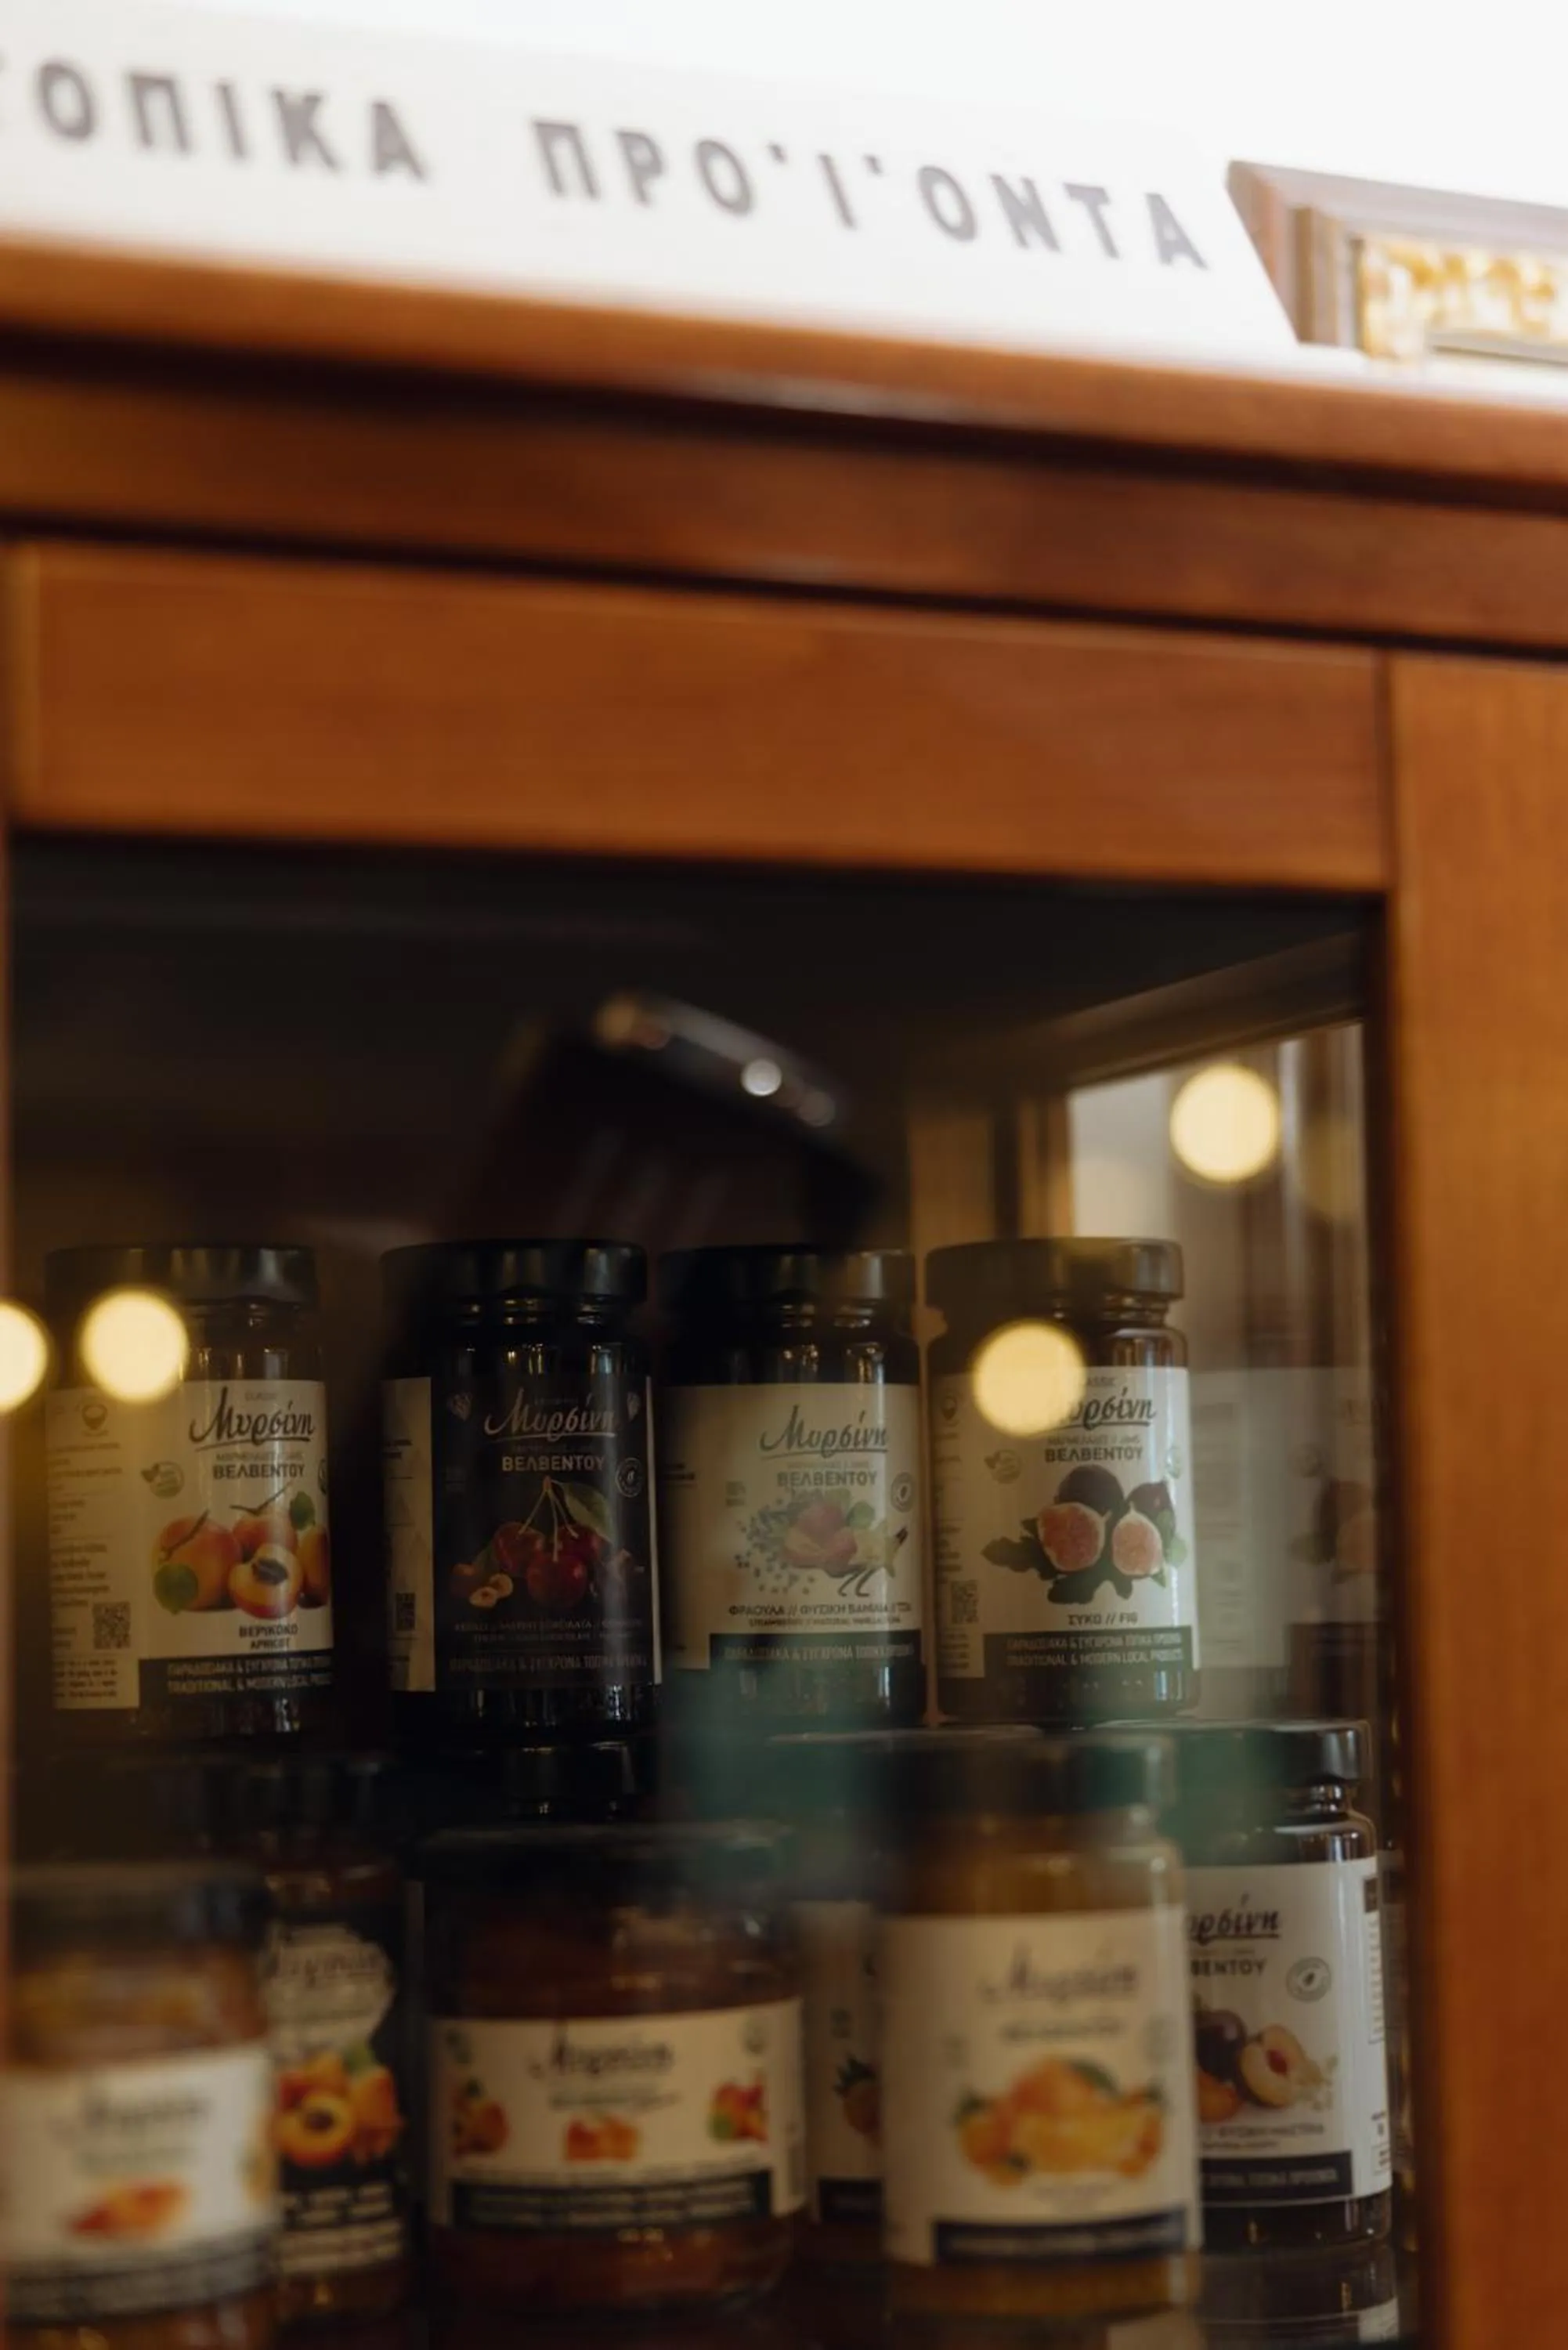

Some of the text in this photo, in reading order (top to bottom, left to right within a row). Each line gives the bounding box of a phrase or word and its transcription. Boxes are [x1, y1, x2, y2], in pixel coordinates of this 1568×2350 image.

[0, 53, 428, 183] ΟΠΙΚΑ
[189, 1384, 315, 1447] Μυρσίνη
[483, 1385, 616, 1442] Μυρσίνη
[1070, 1386, 1156, 1431] υρσίνη
[758, 1403, 888, 1459] Μυρσίνη
[212, 1462, 305, 1480] ΒΕΛΒΕΝΤΟΥ
[501, 1455, 605, 1473] ΒΕΛΒΕΝΤΟΥ
[1044, 1446, 1143, 1464] ΒΕΛΒΕΝΤΟΥ
[776, 1470, 878, 1488] ΒΕΛΒΕΝΤΟΥ
[1190, 1957, 1267, 1976] ΒΕΝΤΟΥ
